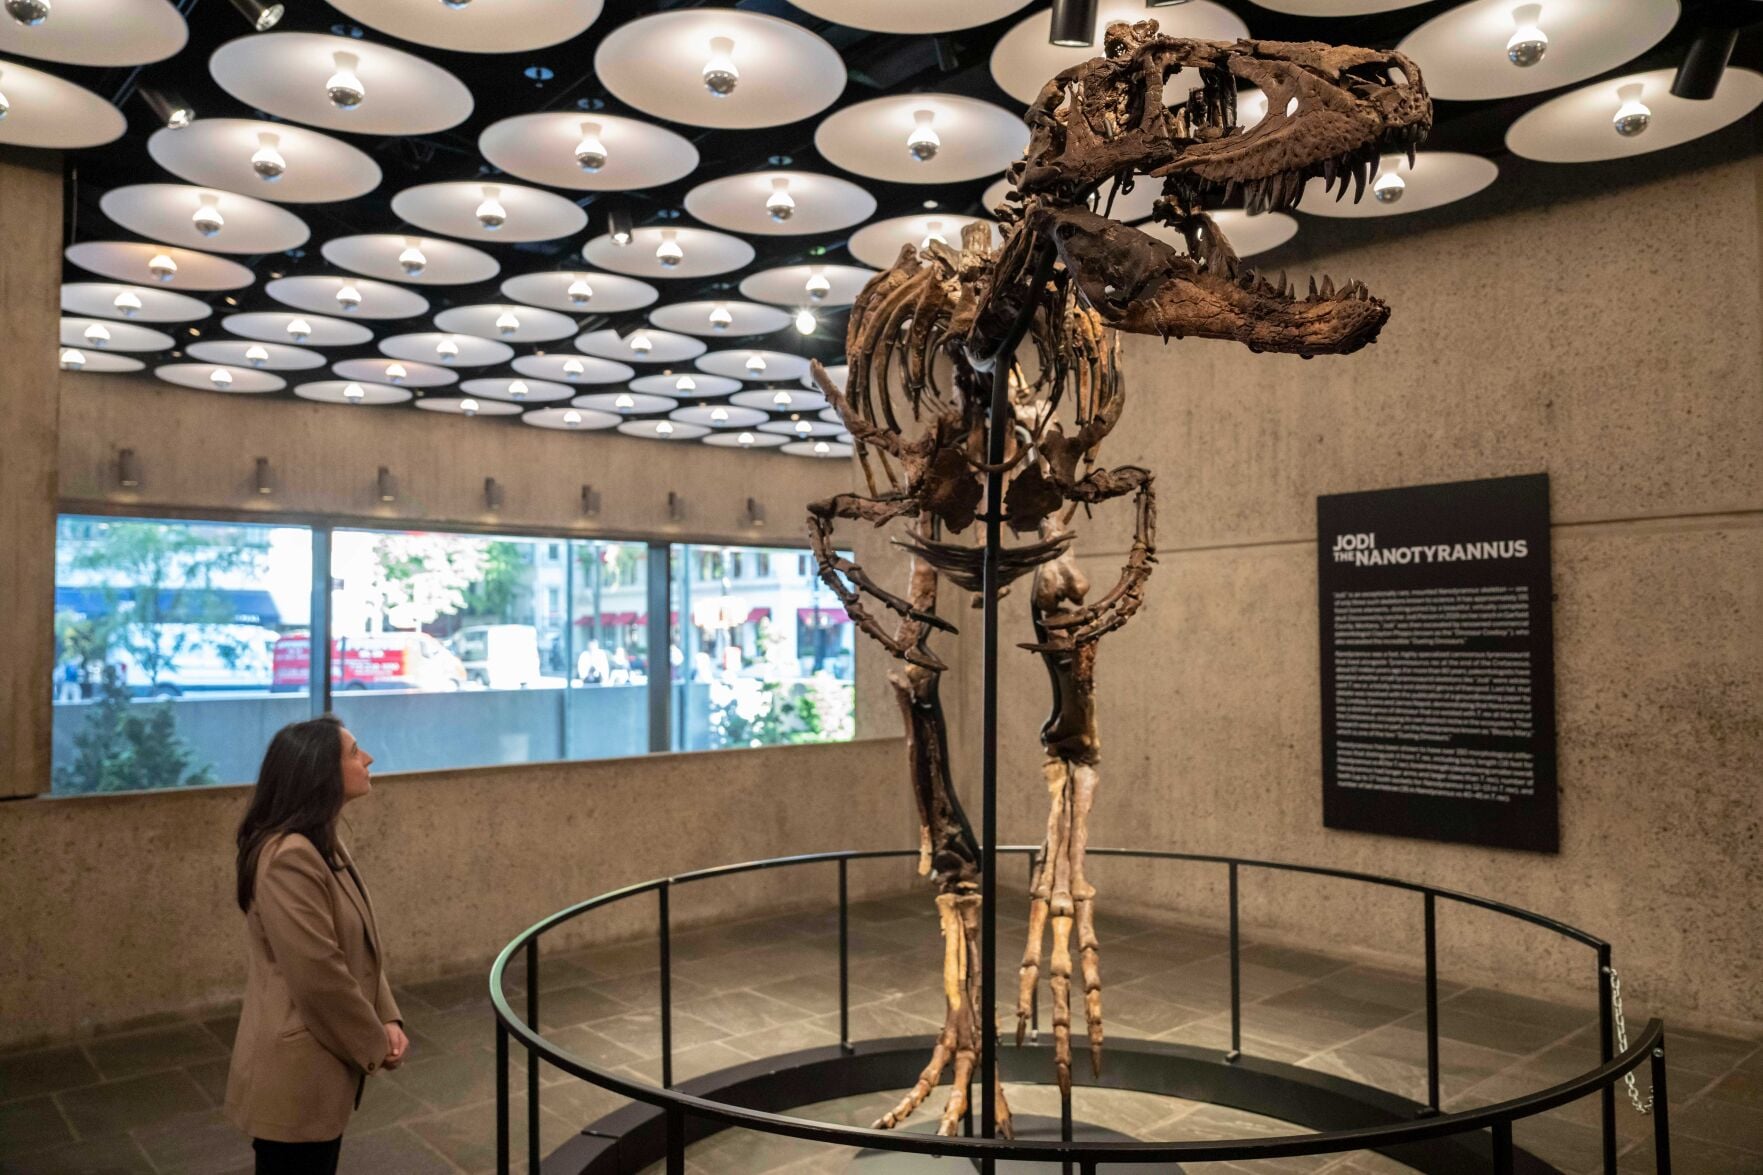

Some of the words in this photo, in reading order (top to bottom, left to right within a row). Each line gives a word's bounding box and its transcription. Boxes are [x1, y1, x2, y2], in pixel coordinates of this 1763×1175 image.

[1332, 532, 1375, 551] JODI
[1333, 551, 1355, 562] THE
[1355, 539, 1529, 567] NANOTYRANNUS
